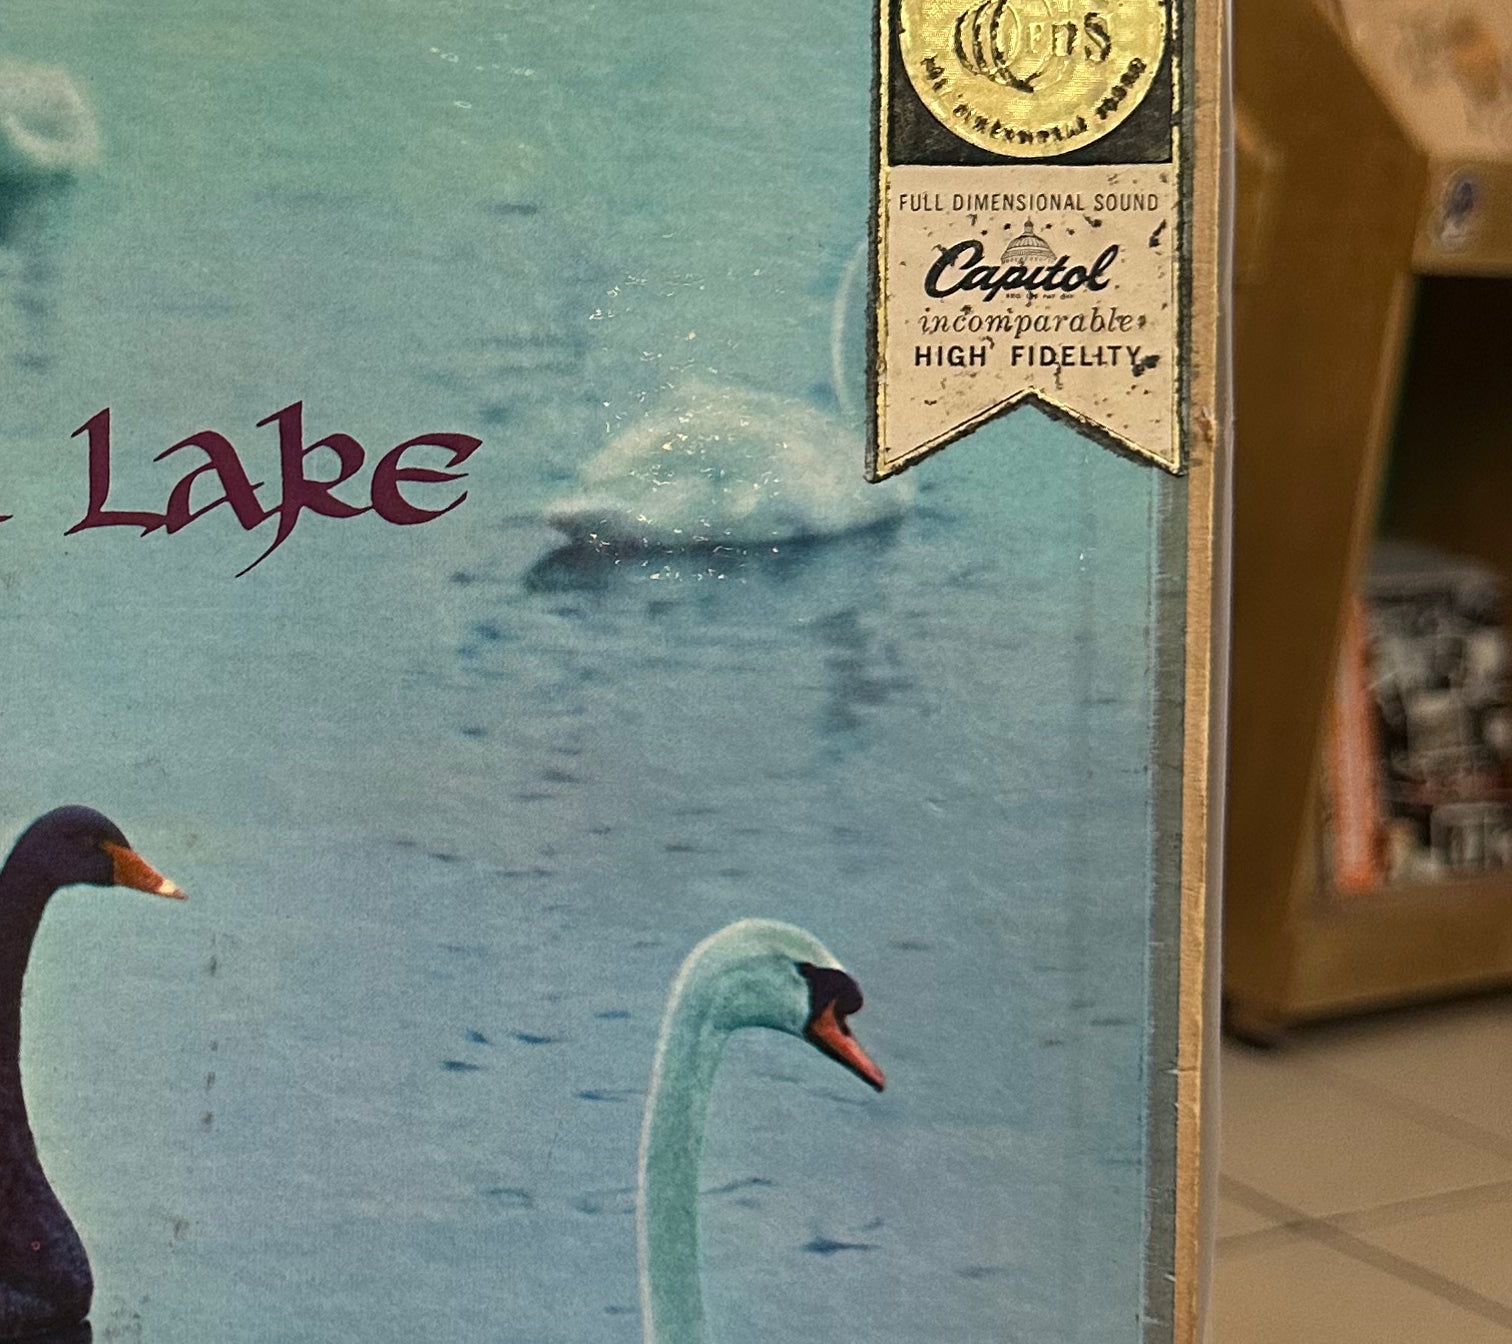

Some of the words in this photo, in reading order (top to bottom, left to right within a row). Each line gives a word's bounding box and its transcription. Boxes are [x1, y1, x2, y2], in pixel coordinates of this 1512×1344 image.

[899, 193, 945, 212] FULL
[952, 193, 1086, 212] DIMENSIONAL
[1093, 193, 1160, 212] SOUND
[924, 239, 1120, 303] Capitol
[919, 306, 1134, 339] incomparable
[914, 345, 987, 368] HIGH
[1010, 345, 1142, 368] FIDELITY
